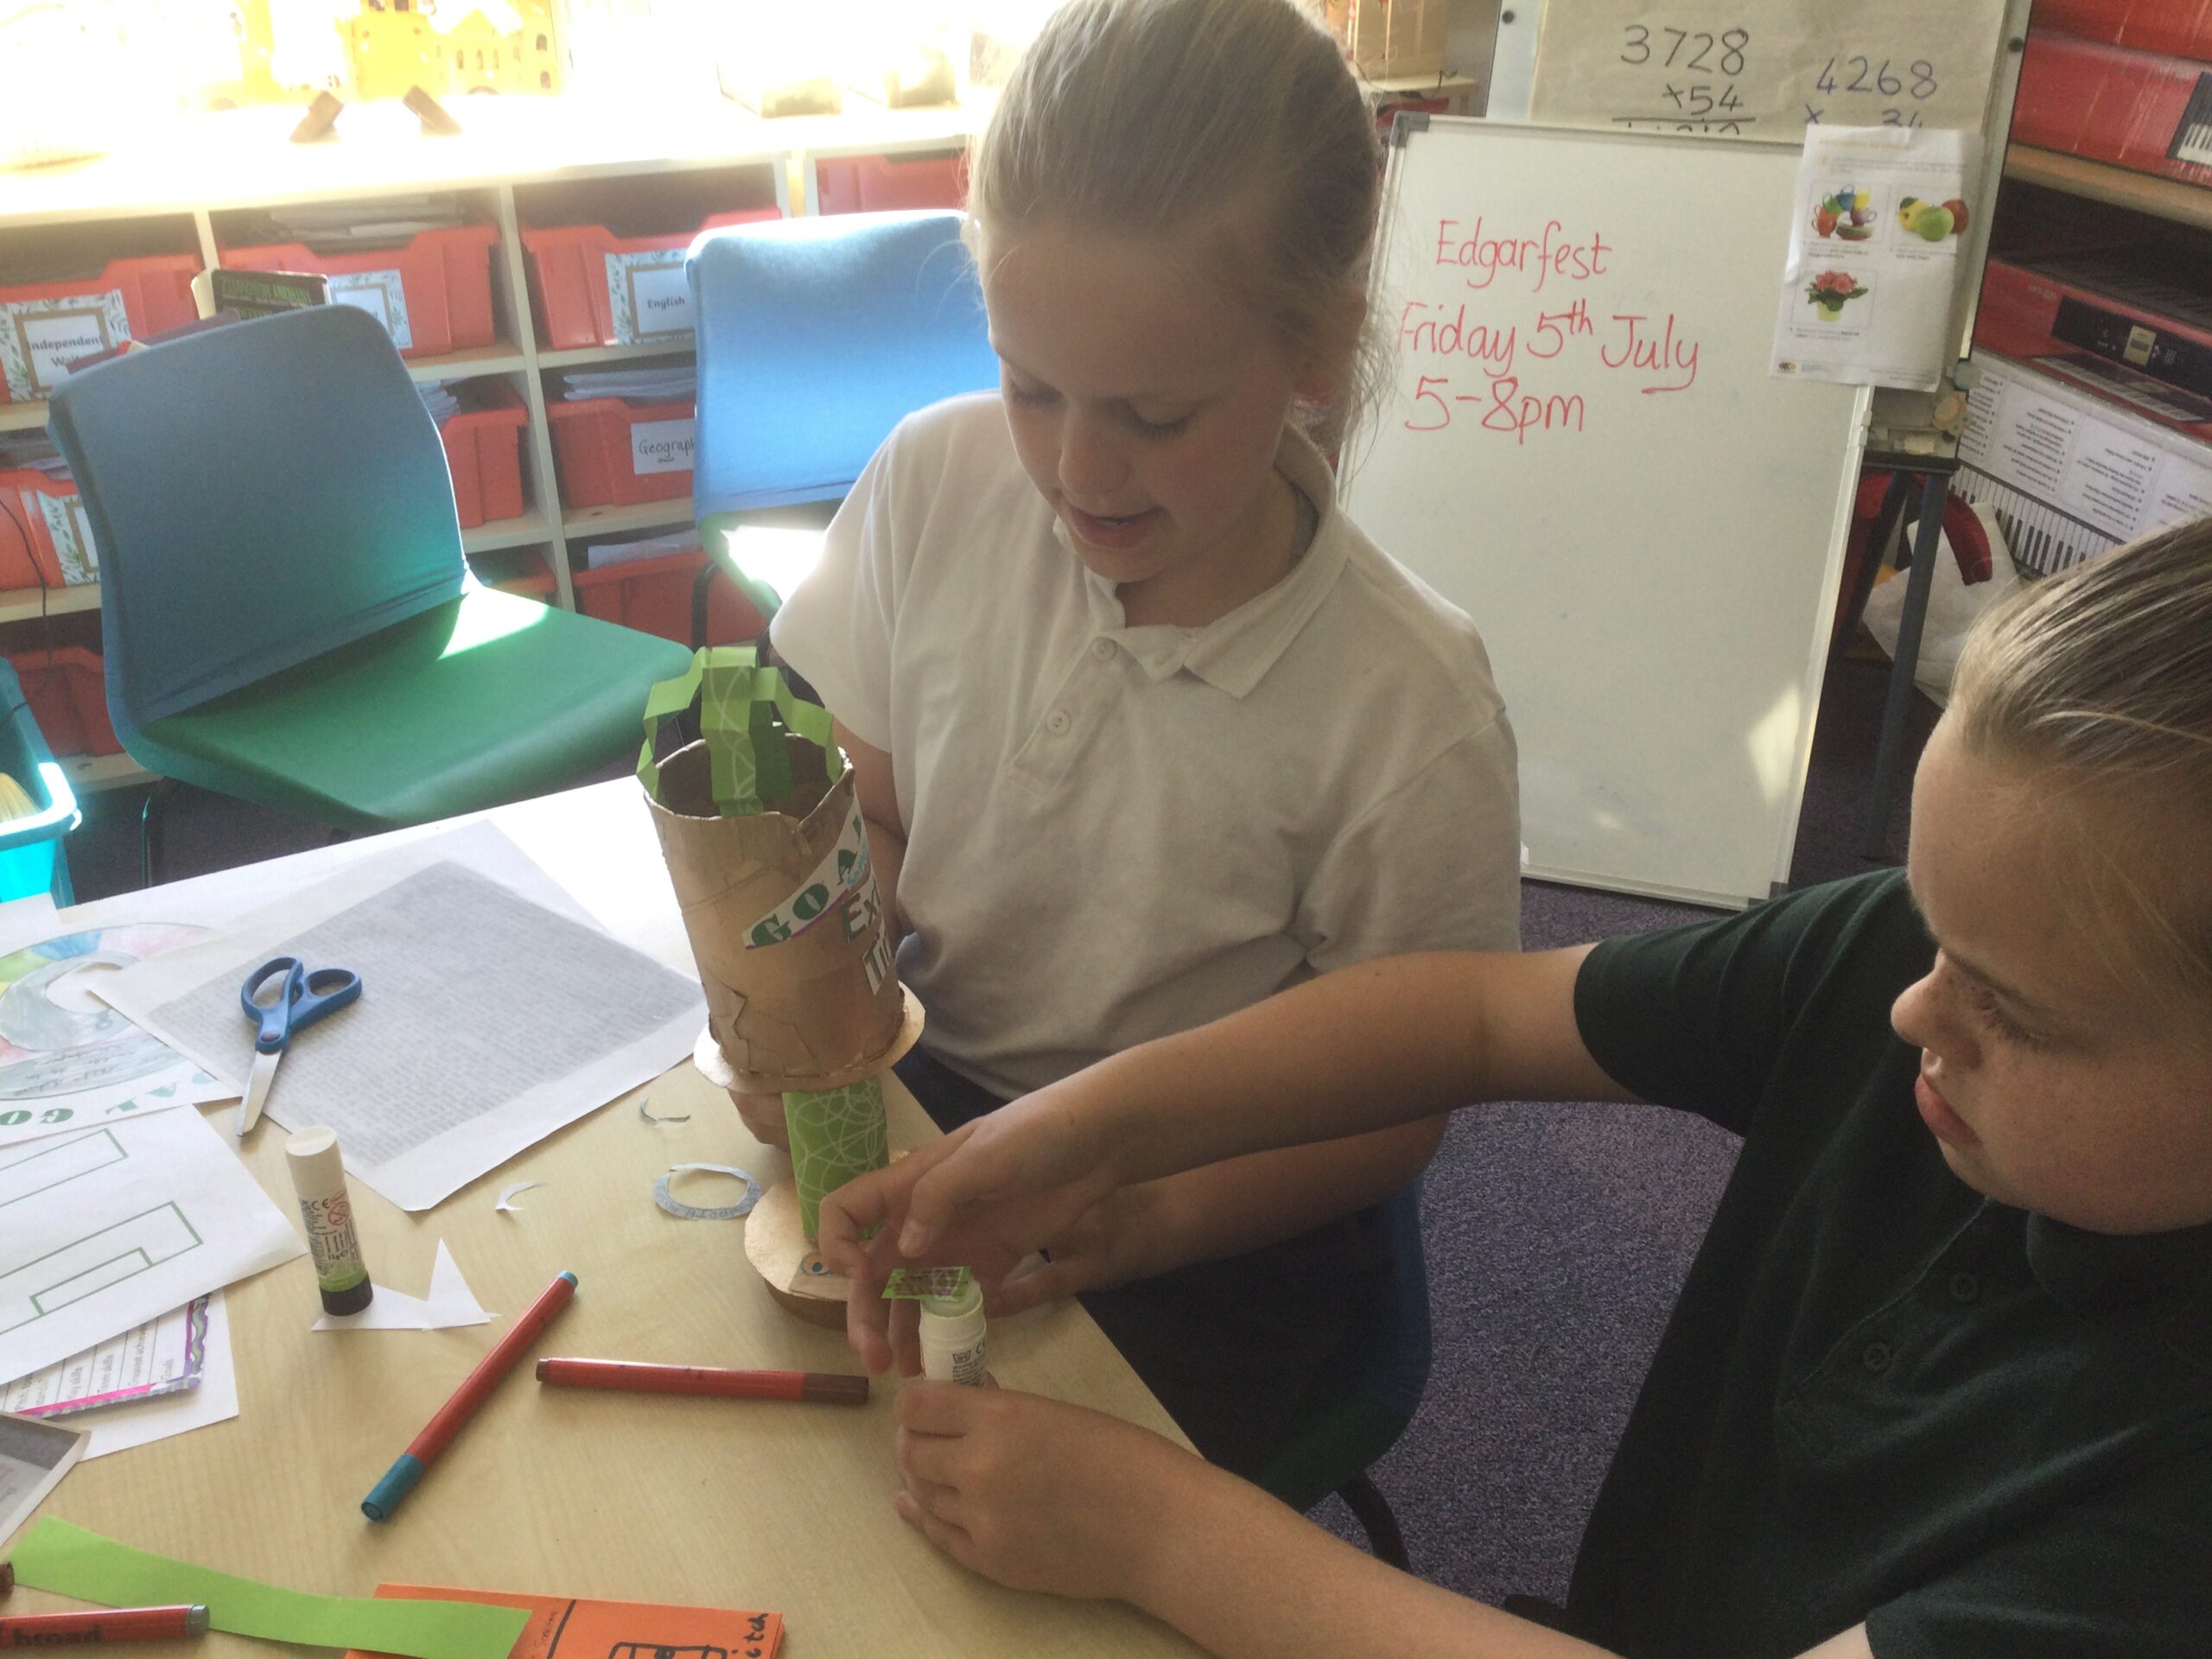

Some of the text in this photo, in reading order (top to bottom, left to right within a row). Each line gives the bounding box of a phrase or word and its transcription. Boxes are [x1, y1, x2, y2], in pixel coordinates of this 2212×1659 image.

[1620, 24, 1751, 77] 3728
[1816, 57, 1938, 100] 4268
[1436, 217, 1613, 291] Edgarfest
[646, 296, 686, 310] English
[1401, 298, 1700, 394] Friday 5th July
[1404, 378, 1586, 445] 5-8pm
